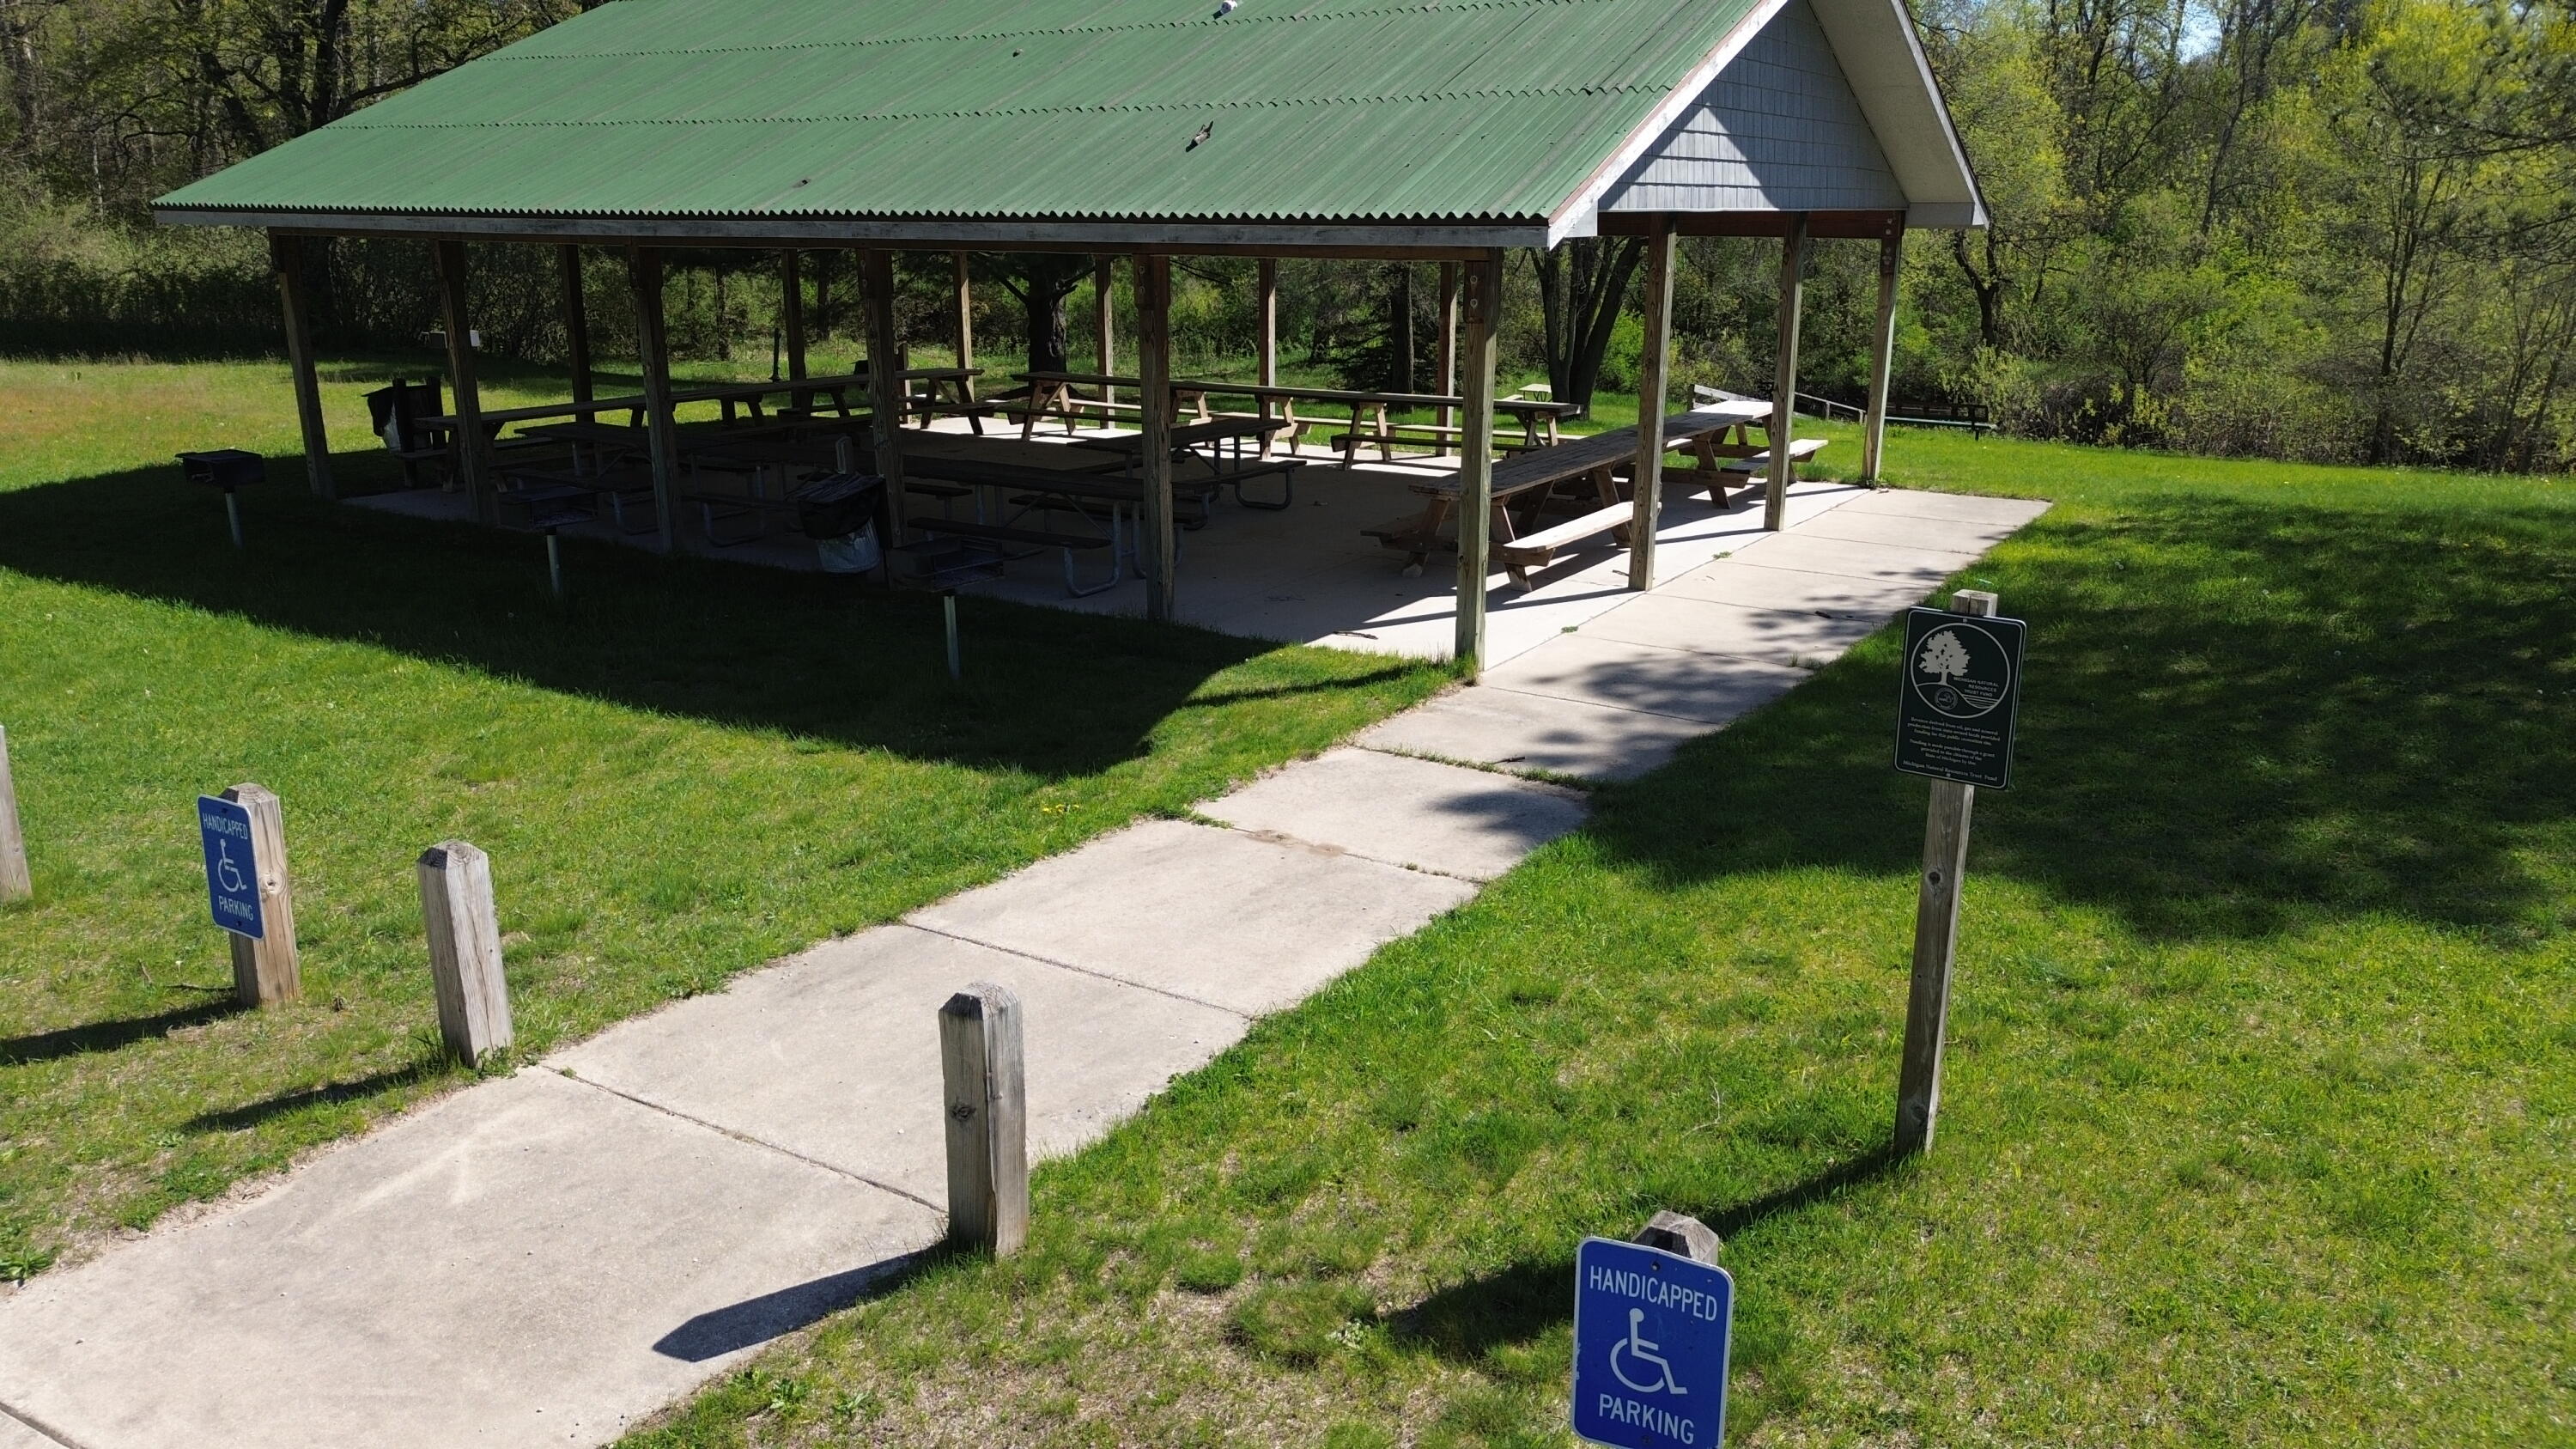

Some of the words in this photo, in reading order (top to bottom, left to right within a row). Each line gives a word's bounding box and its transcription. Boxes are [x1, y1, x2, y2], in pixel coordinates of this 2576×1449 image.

[203, 813, 248, 840] HANDICAPPED
[218, 895, 254, 921] PARKING
[1589, 1265, 1717, 1321] HANDICAPPED
[1599, 1393, 1694, 1445] PARKING
